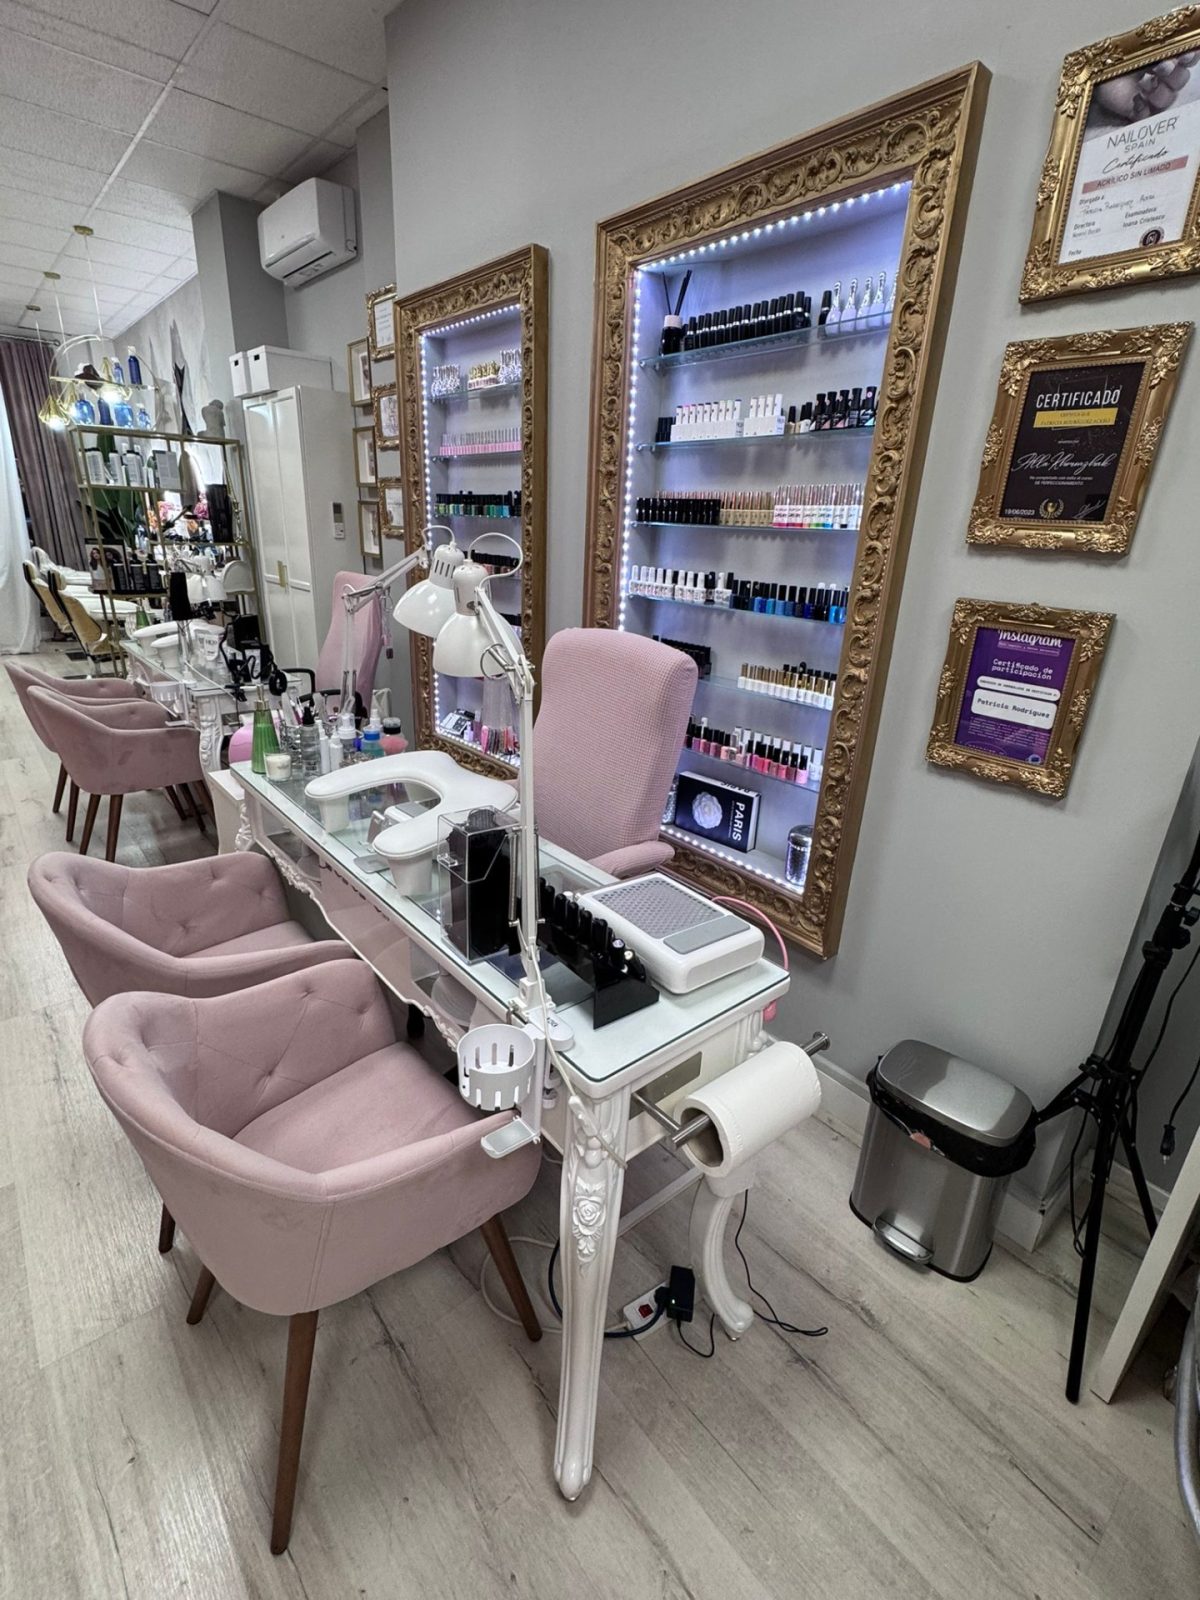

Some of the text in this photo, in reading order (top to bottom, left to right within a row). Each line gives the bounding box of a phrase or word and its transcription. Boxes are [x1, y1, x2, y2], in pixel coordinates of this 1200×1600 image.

[1107, 117, 1177, 148] NAILOVER
[1124, 138, 1155, 153] SPAIN
[1130, 170, 1142, 180] SIN
[1036, 389, 1121, 408] CERTIFICADO
[992, 665, 1052, 680] participación
[993, 658, 1053, 675] Certificado de
[977, 698, 1009, 709] Patricia
[732, 802, 745, 841] PARIS
